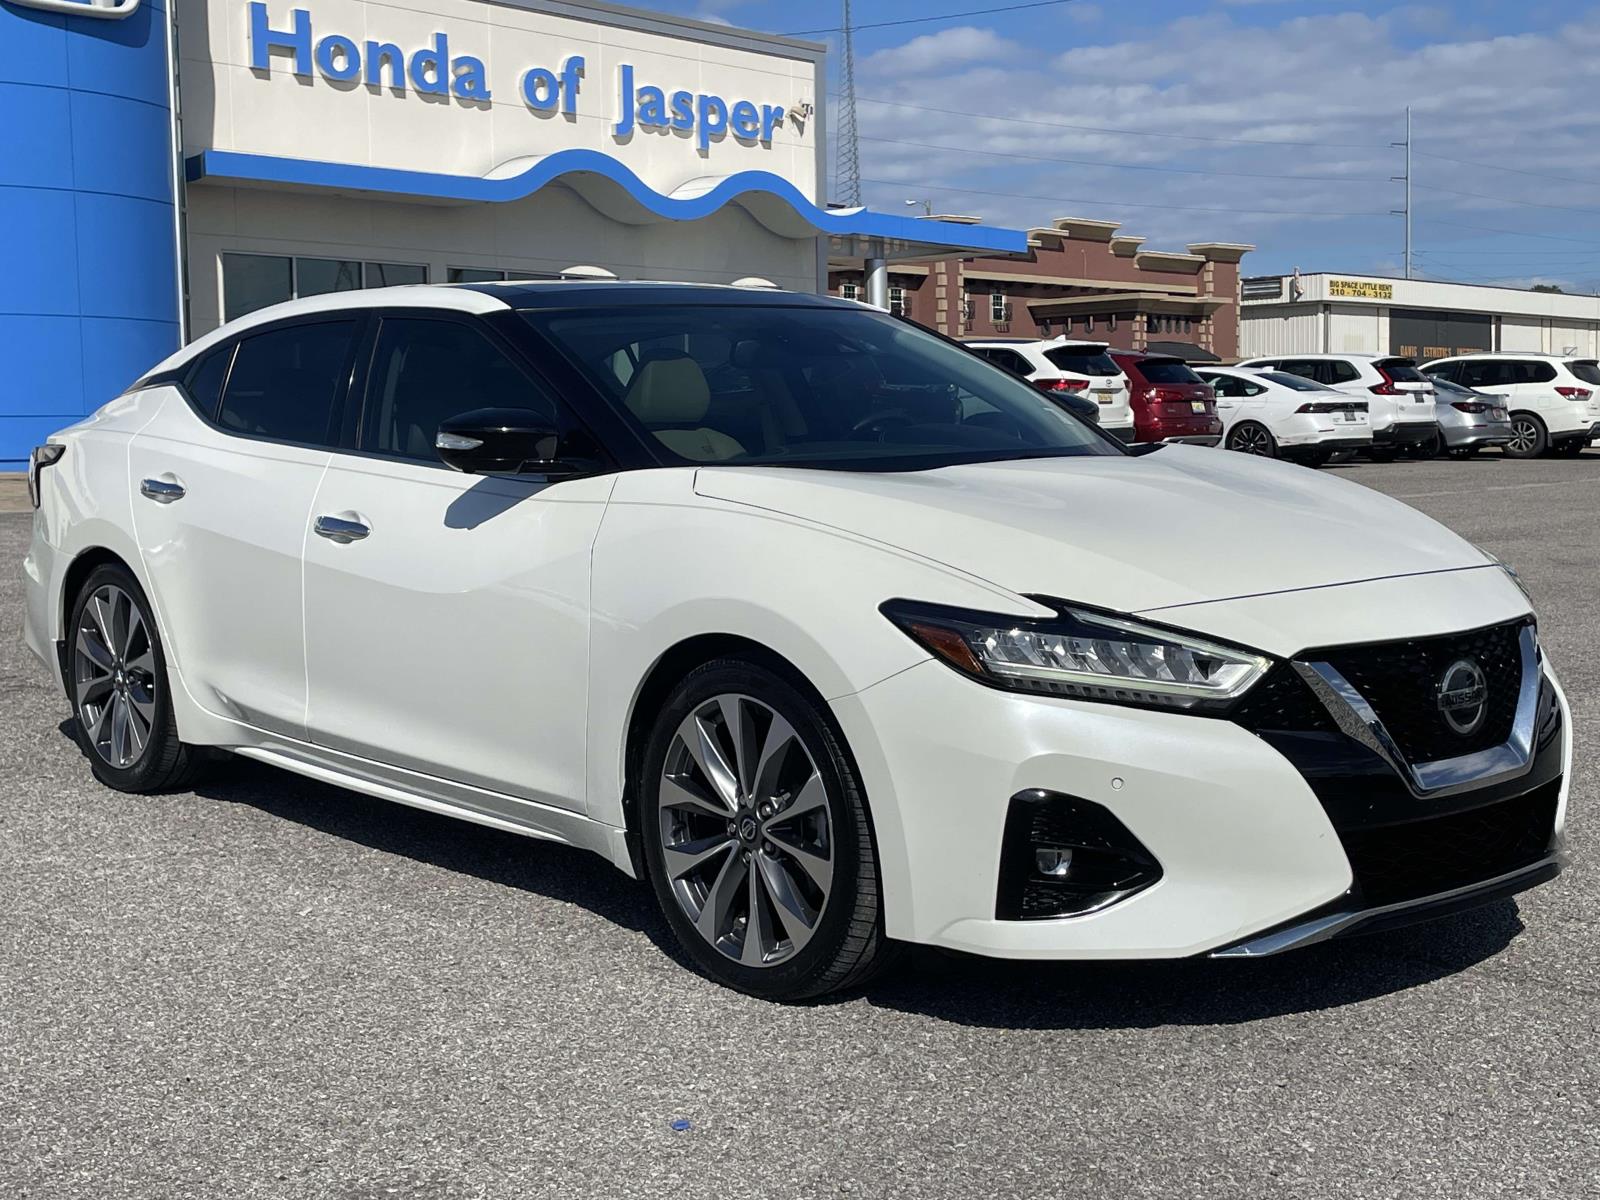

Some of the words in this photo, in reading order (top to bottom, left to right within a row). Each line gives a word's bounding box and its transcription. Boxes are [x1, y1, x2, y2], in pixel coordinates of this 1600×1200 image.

[248, 2, 491, 103] Honda
[520, 56, 585, 113] of
[612, 64, 785, 150] Jasper
[1329, 280, 1340, 288] BIG
[1340, 281, 1358, 290] SPACE
[1359, 282, 1377, 291] LITTLE
[1378, 284, 1392, 292] RENT
[1329, 288, 1345, 296] 310
[1351, 289, 1366, 297] 704
[1373, 291, 1392, 299] 3132
